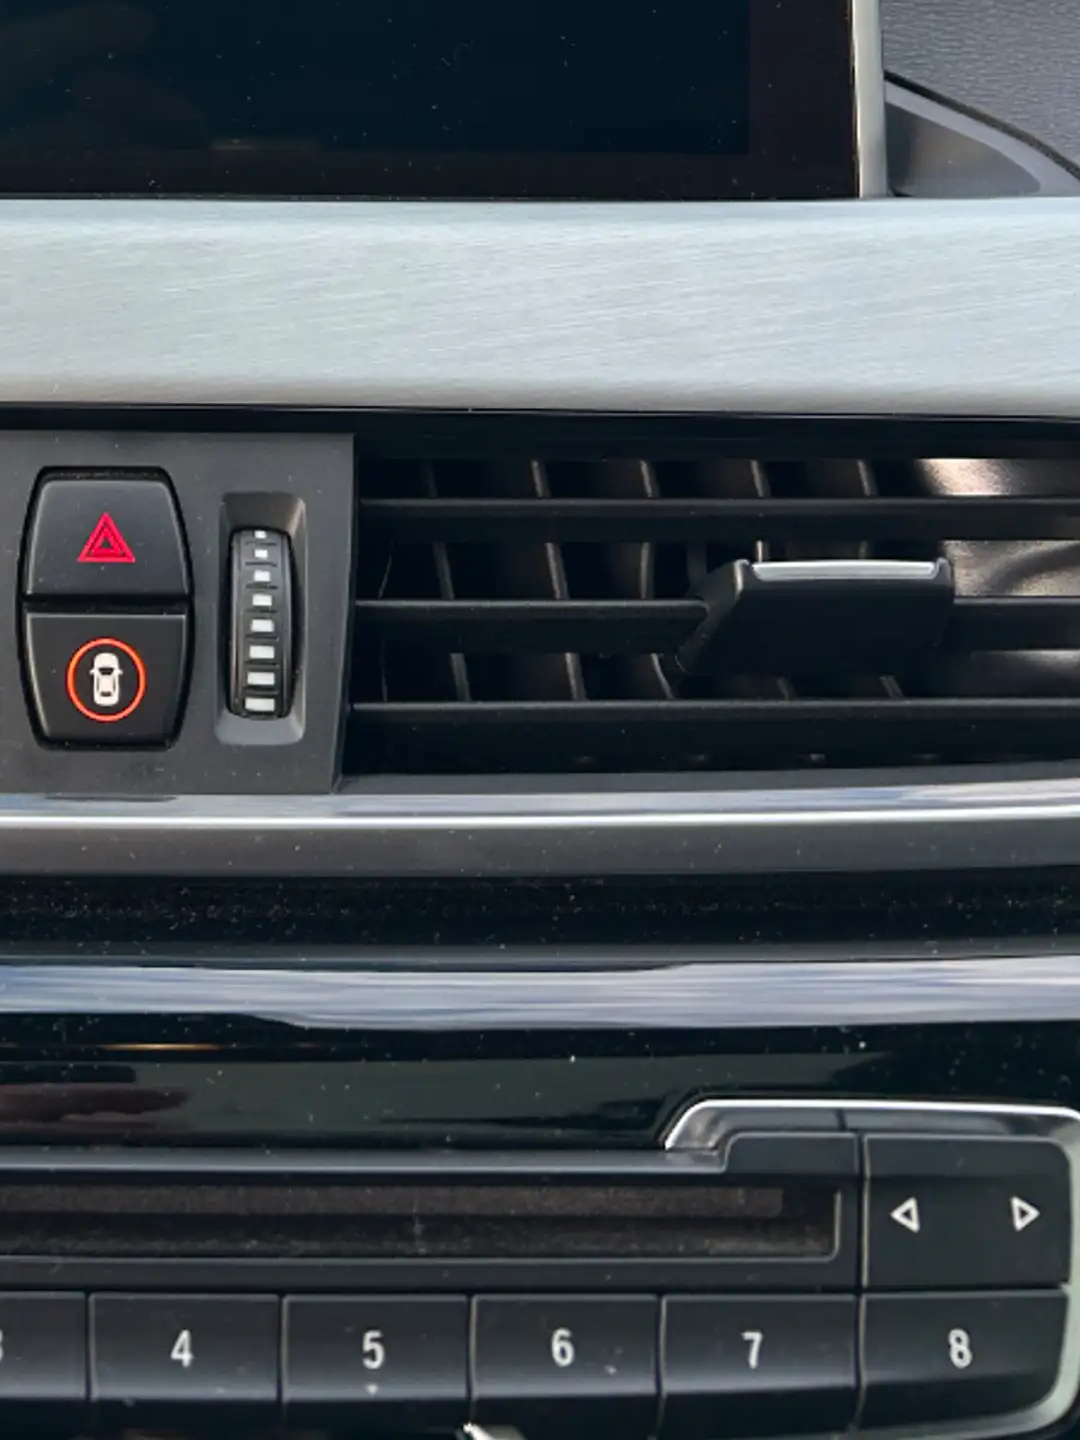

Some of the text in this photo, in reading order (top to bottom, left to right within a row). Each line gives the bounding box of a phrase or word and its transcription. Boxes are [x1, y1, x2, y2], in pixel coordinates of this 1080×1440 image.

[170, 1329, 194, 1367] 4
[361, 1329, 385, 1369] 5
[551, 1328, 575, 1366] 6
[743, 1330, 765, 1368] 7
[948, 1329, 973, 1368] 8
